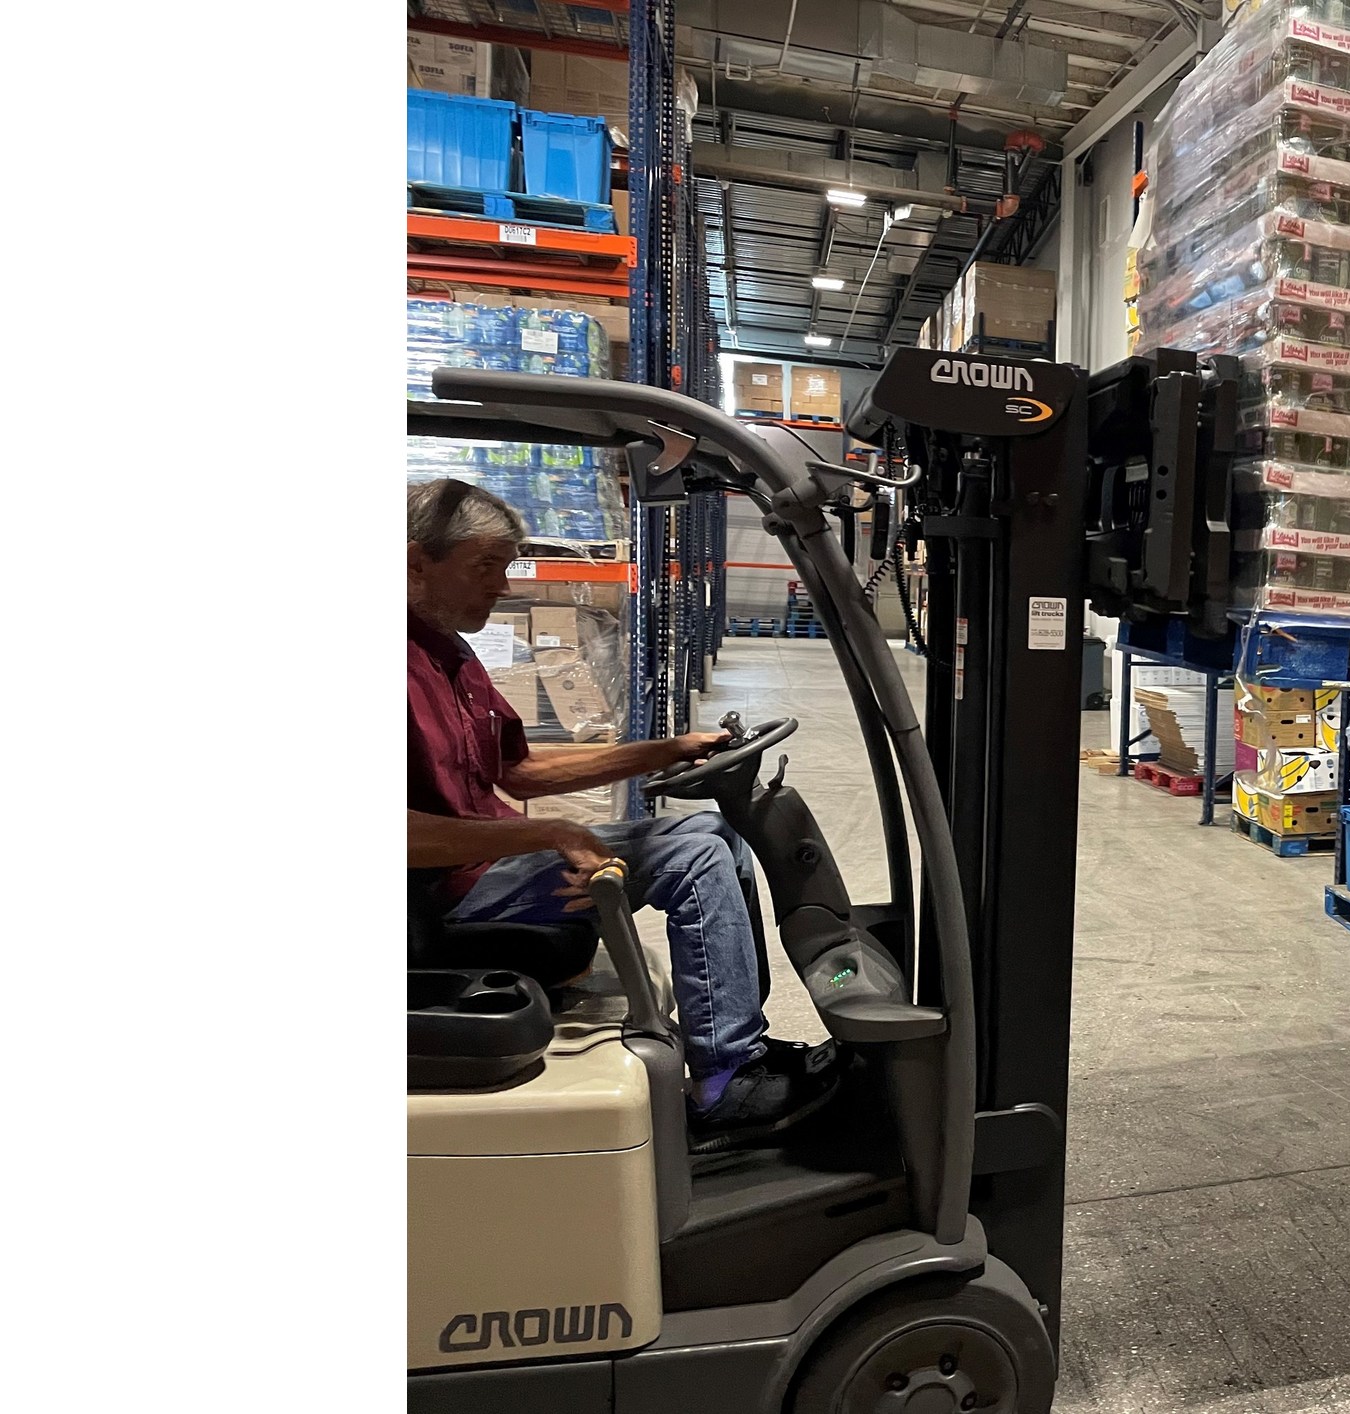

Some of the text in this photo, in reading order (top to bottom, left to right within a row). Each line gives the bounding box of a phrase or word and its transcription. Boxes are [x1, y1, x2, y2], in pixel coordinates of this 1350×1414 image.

[930, 358, 1033, 392] CROWN
[1005, 404, 1032, 415] SC
[1032, 601, 1064, 610] CROWN
[439, 1302, 632, 1353] CROWN
